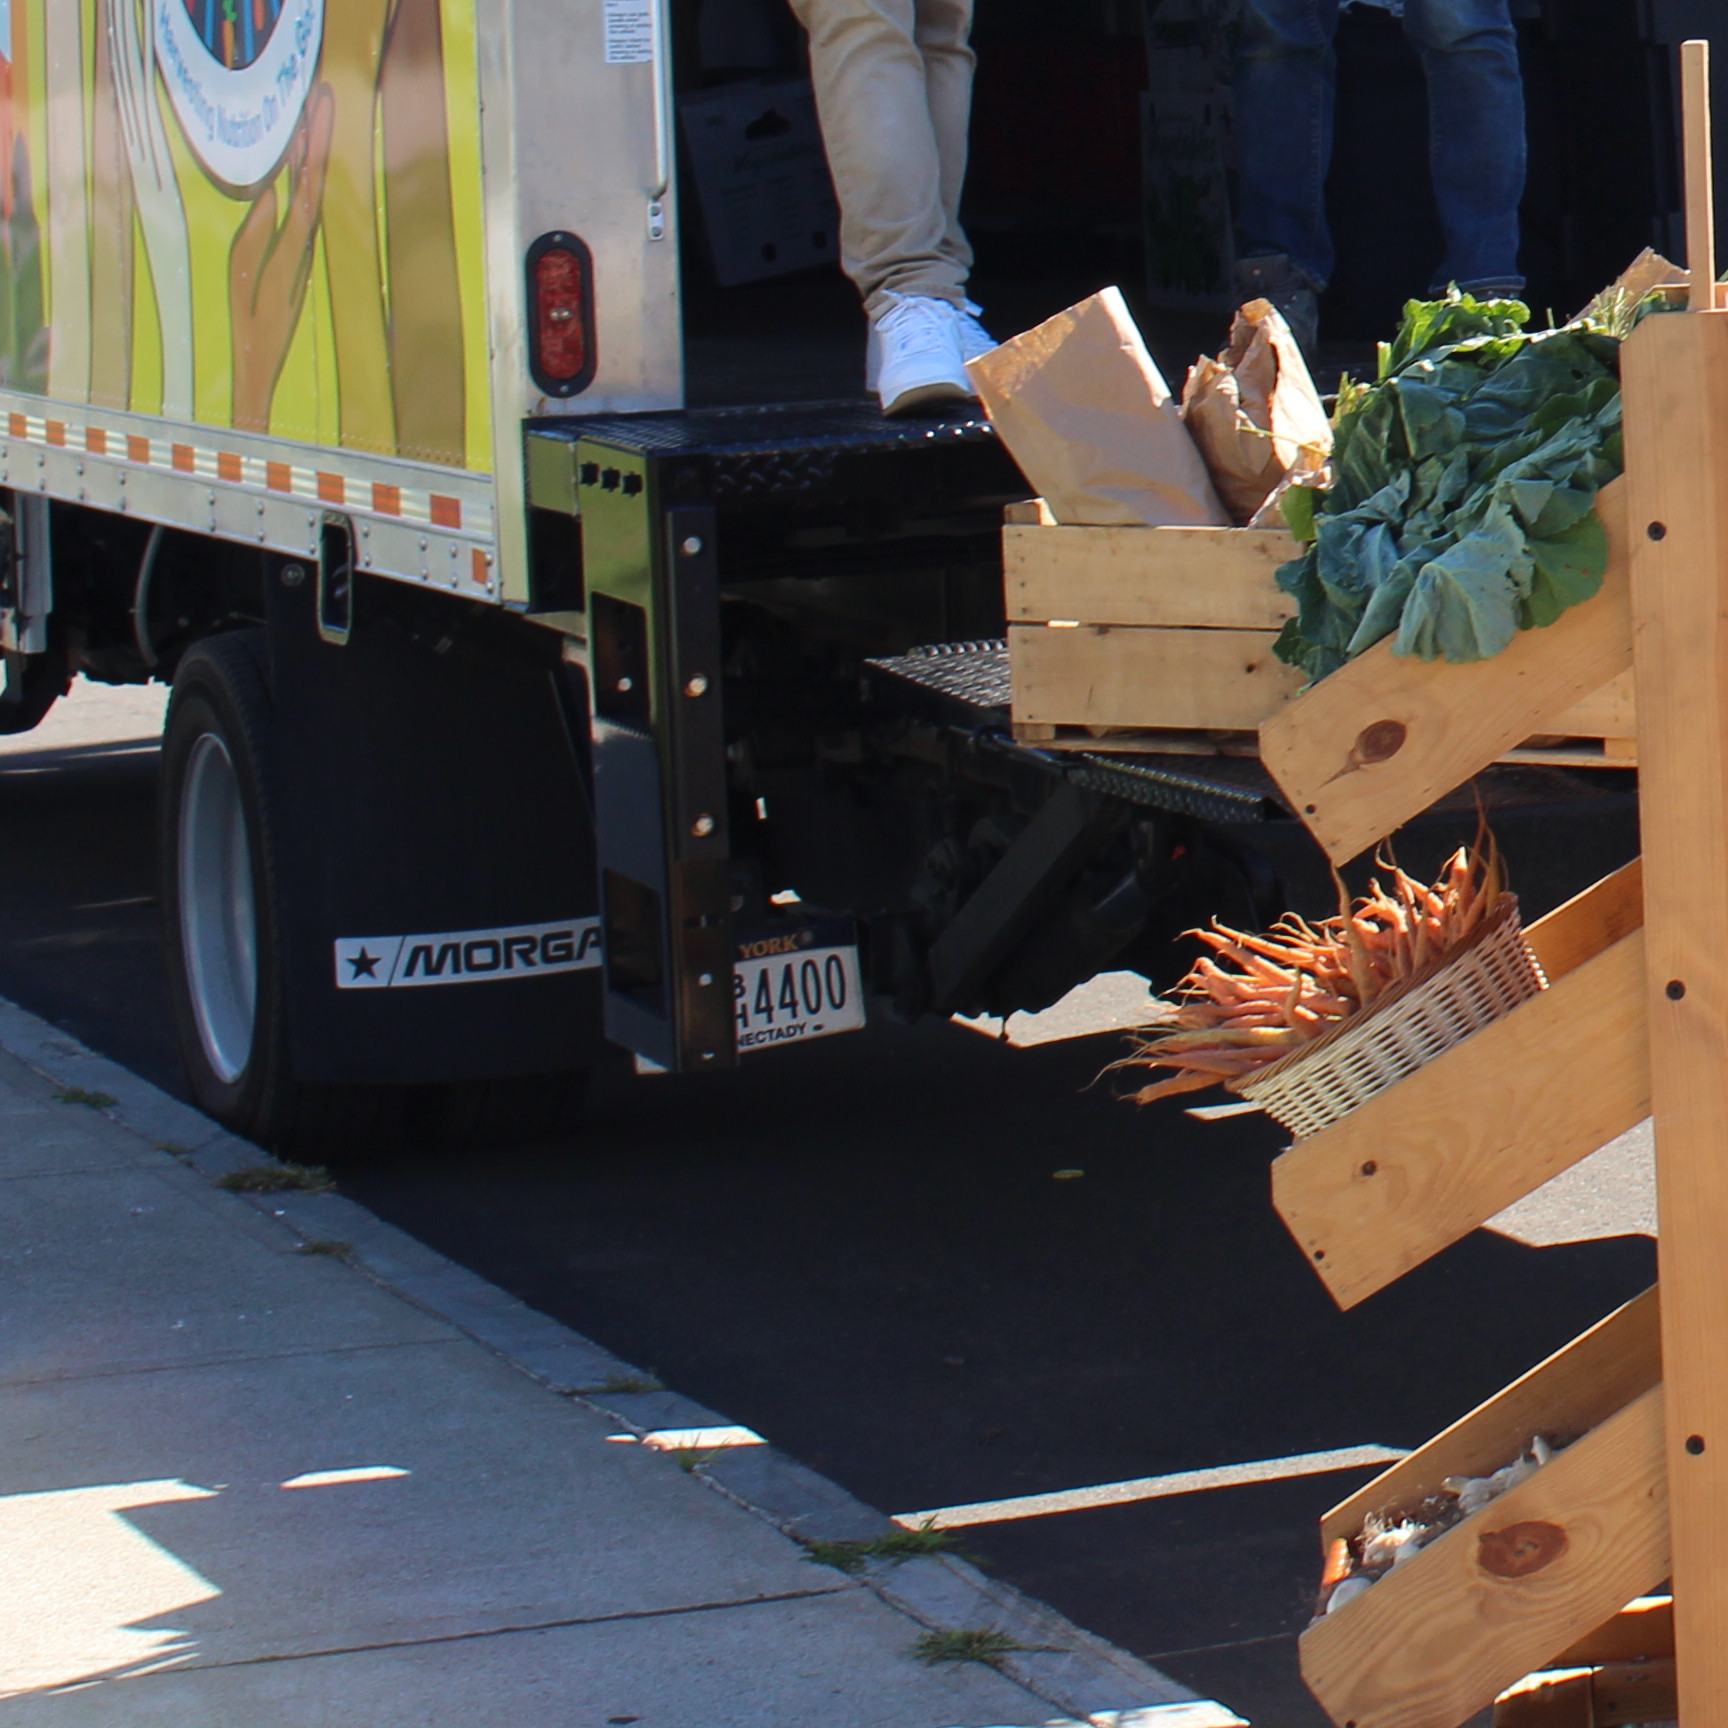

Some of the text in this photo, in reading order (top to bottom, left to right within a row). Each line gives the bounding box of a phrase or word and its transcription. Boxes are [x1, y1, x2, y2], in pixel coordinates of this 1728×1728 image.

[217, 104, 263, 149] Nutrition
[403, 925, 601, 978] MORGA
[737, 933, 800, 960] YORK
[753, 953, 847, 1024] 4400
[738, 1022, 807, 1048] NECTADY
